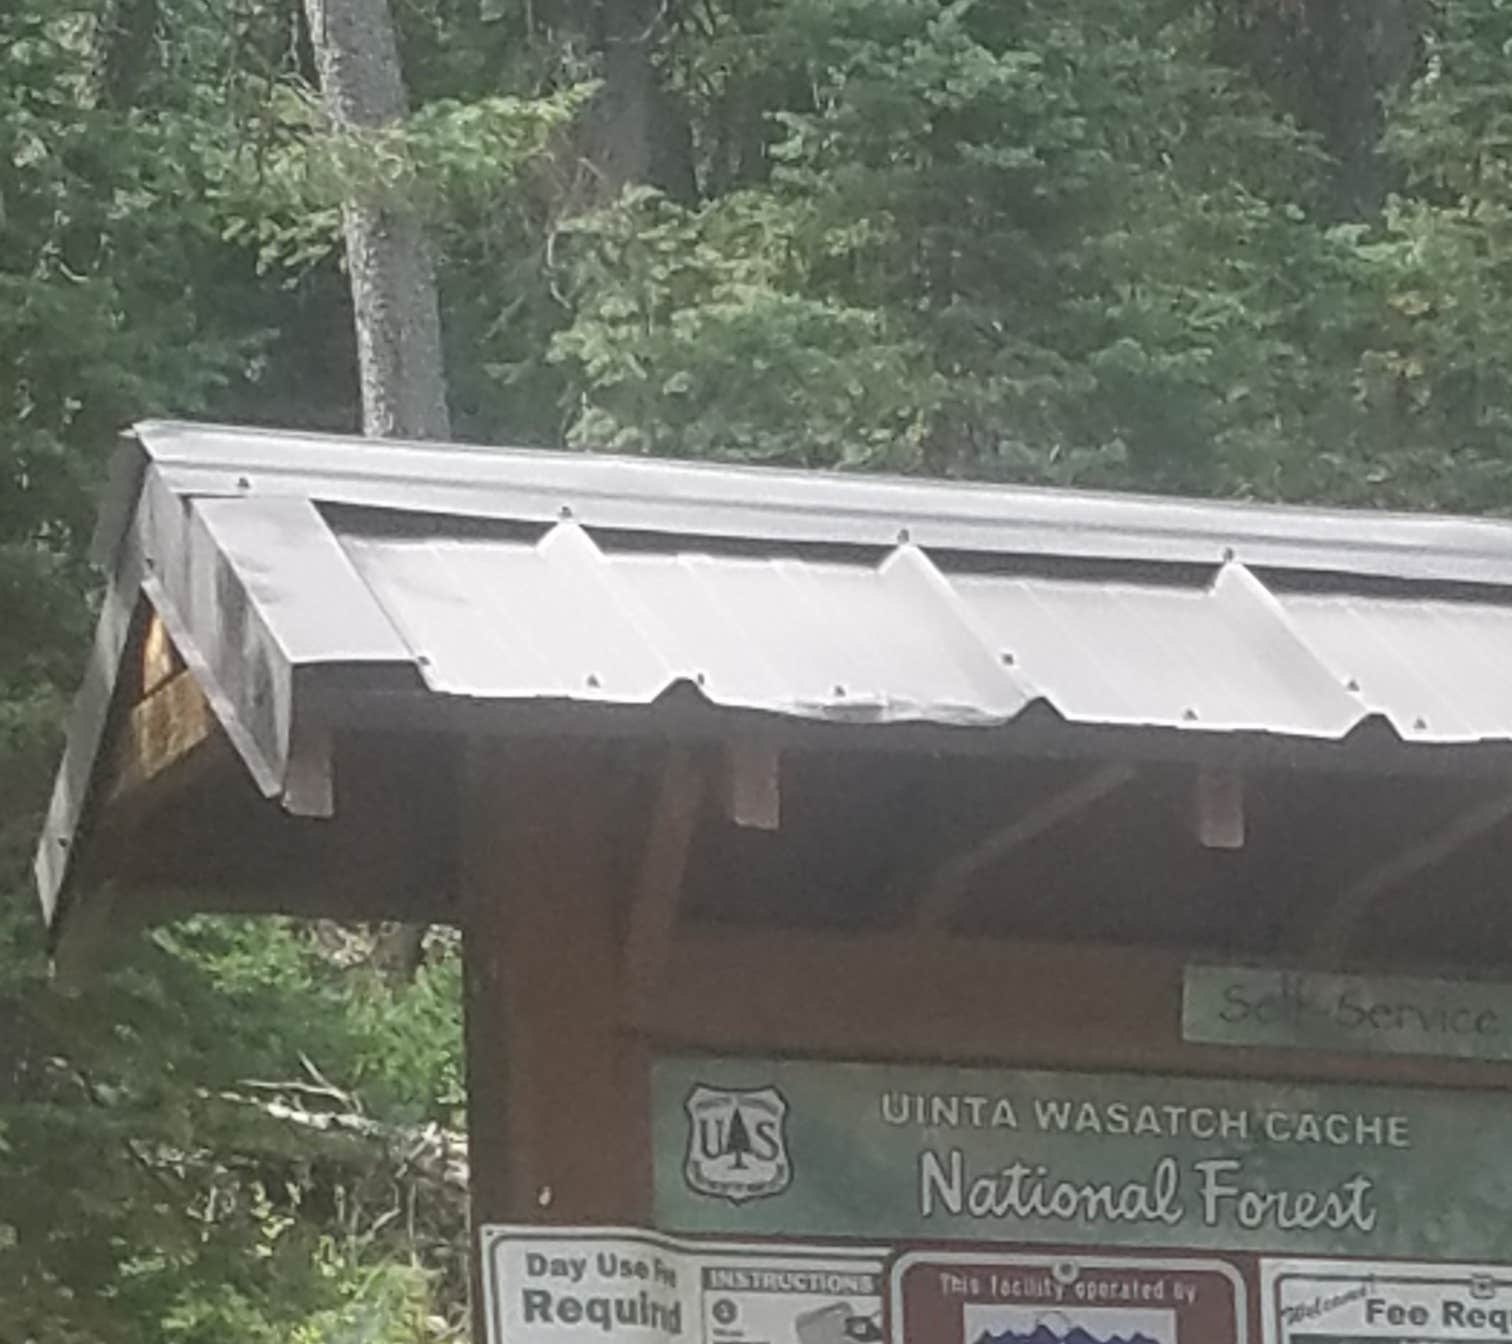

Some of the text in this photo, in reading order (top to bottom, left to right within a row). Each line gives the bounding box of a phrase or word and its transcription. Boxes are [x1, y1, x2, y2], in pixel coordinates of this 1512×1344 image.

[882, 1093, 1412, 1147] UINTA WASATCH CACHE
[921, 1150, 1377, 1231] National Forest
[525, 1252, 587, 1283] Day
[596, 1252, 649, 1279] Use
[939, 1273, 980, 1296] This
[1074, 1277, 1165, 1302] operated
[1365, 1299, 1430, 1326] Fee
